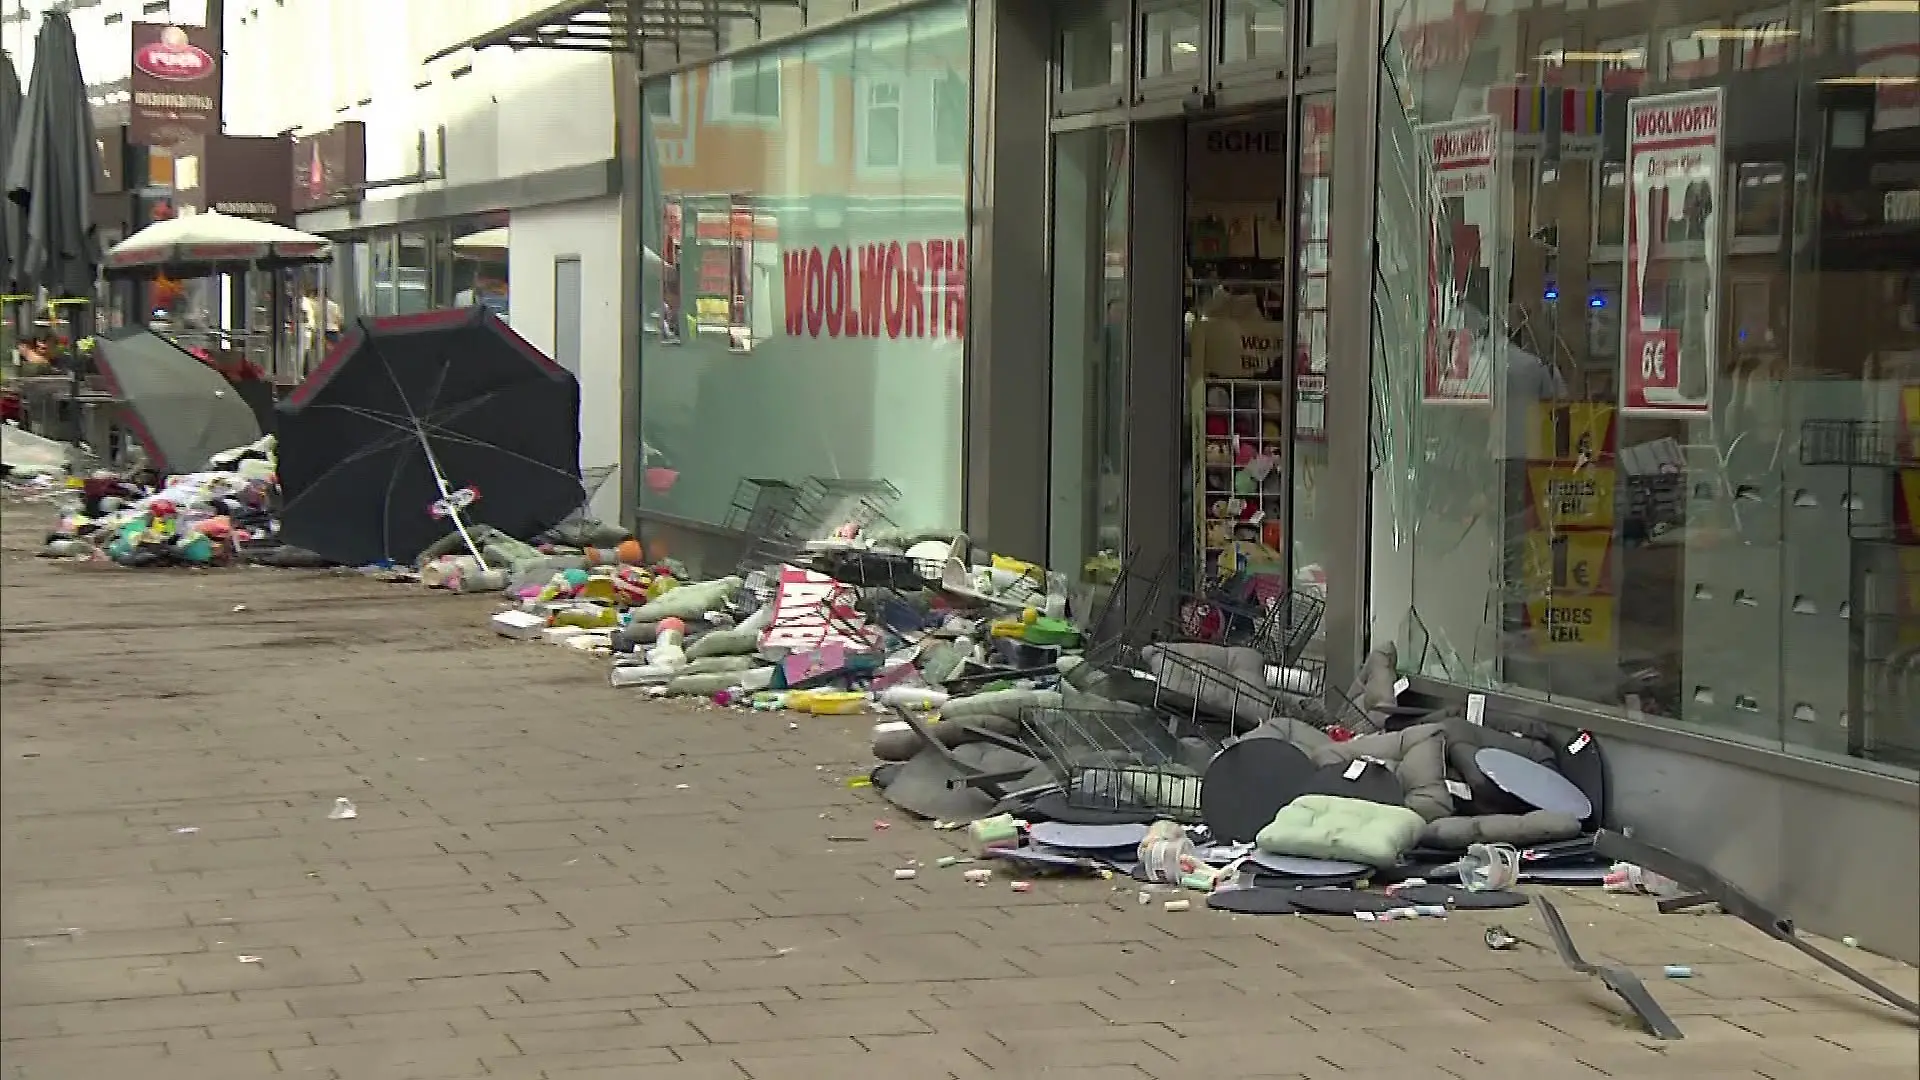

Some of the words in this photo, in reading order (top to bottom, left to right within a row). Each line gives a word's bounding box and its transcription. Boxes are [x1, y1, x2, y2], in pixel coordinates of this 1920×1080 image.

[1635, 104, 1717, 137] WOOLWORTH
[783, 238, 966, 339] WOOLWORTH
[1641, 339, 1666, 380] 6€
[1540, 607, 1593, 625] JEDES
[1550, 626, 1584, 642] TEIL
